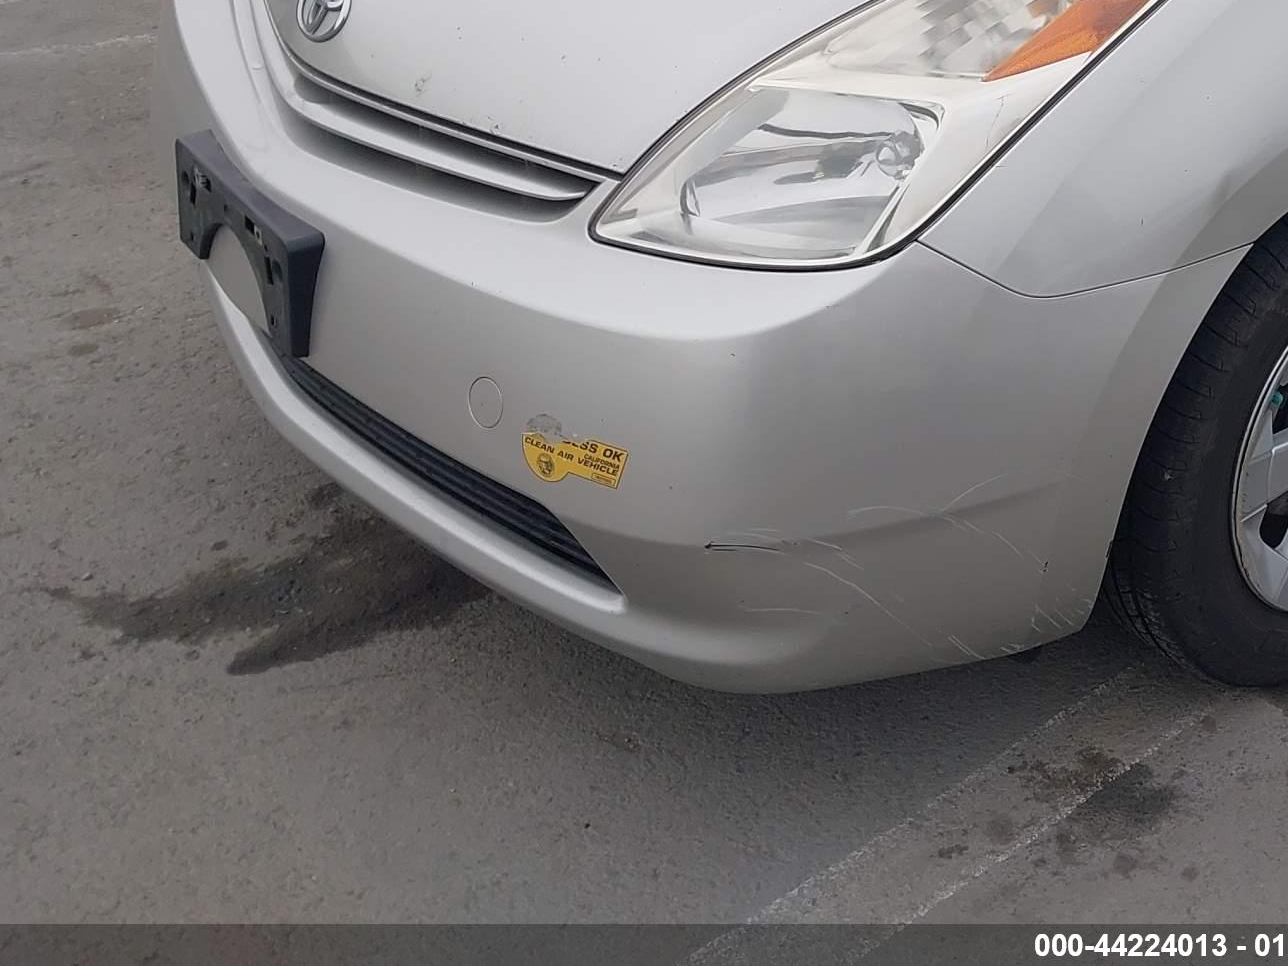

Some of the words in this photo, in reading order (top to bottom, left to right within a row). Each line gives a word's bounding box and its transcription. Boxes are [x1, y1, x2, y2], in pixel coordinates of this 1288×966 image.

[524, 436, 555, 454] CLEAN
[556, 450, 575, 462] AIR
[577, 457, 619, 477] VEHICLE
[602, 447, 625, 463] OK
